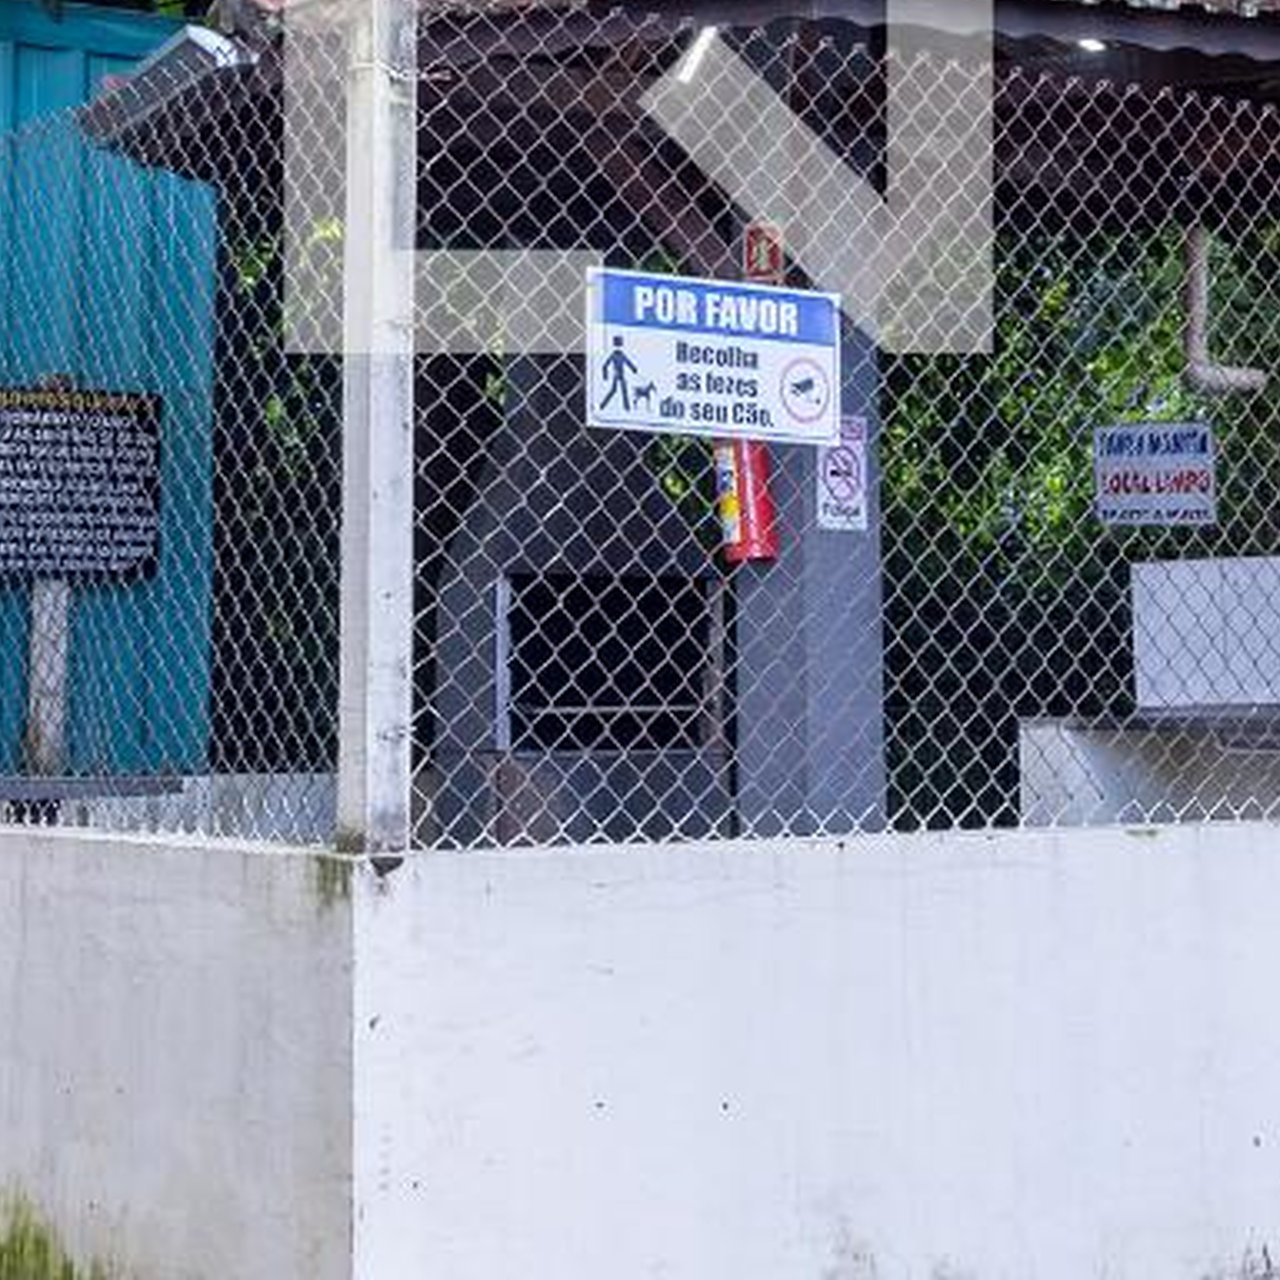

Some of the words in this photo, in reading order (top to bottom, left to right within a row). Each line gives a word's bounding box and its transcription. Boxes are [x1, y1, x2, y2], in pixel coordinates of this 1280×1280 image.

[633, 285, 697, 325] POR
[706, 292, 799, 336] FAVOR
[675, 341, 759, 369] Recolha
[675, 372, 701, 393] as
[706, 371, 758, 398] fezes
[659, 396, 685, 419] do
[690, 403, 728, 423] seu
